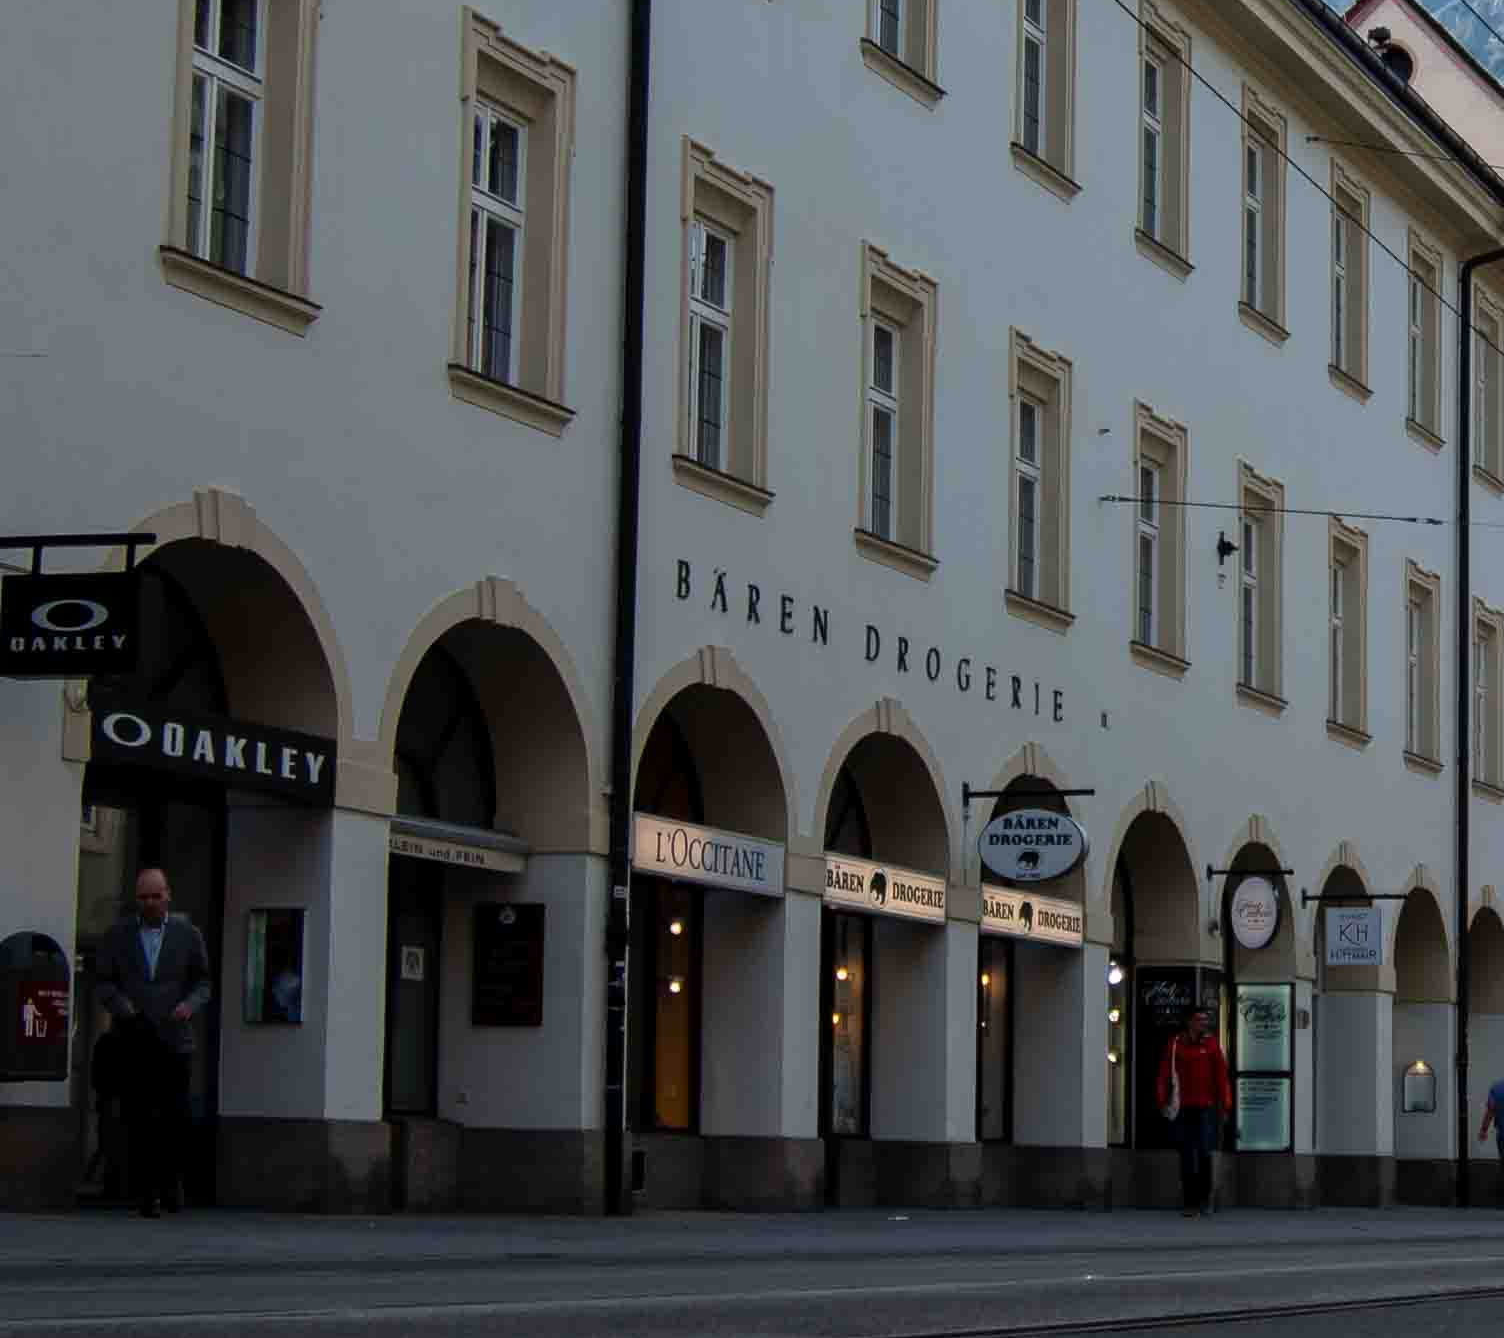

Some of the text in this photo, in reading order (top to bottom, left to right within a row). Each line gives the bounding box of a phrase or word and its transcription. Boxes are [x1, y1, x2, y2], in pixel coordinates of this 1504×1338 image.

[8, 634, 127, 652] OAKLEY
[675, 558, 1065, 723] BÄREN DROGERIE
[161, 720, 326, 784] OAKLEY
[988, 833, 1073, 846] DROGERIE
[1003, 814, 1059, 830] BÄREN
[655, 828, 766, 881] L'OCCITANE
[826, 864, 944, 909] BÄREN DROGERIE
[983, 894, 1082, 934] BÄREN DROGERIE
